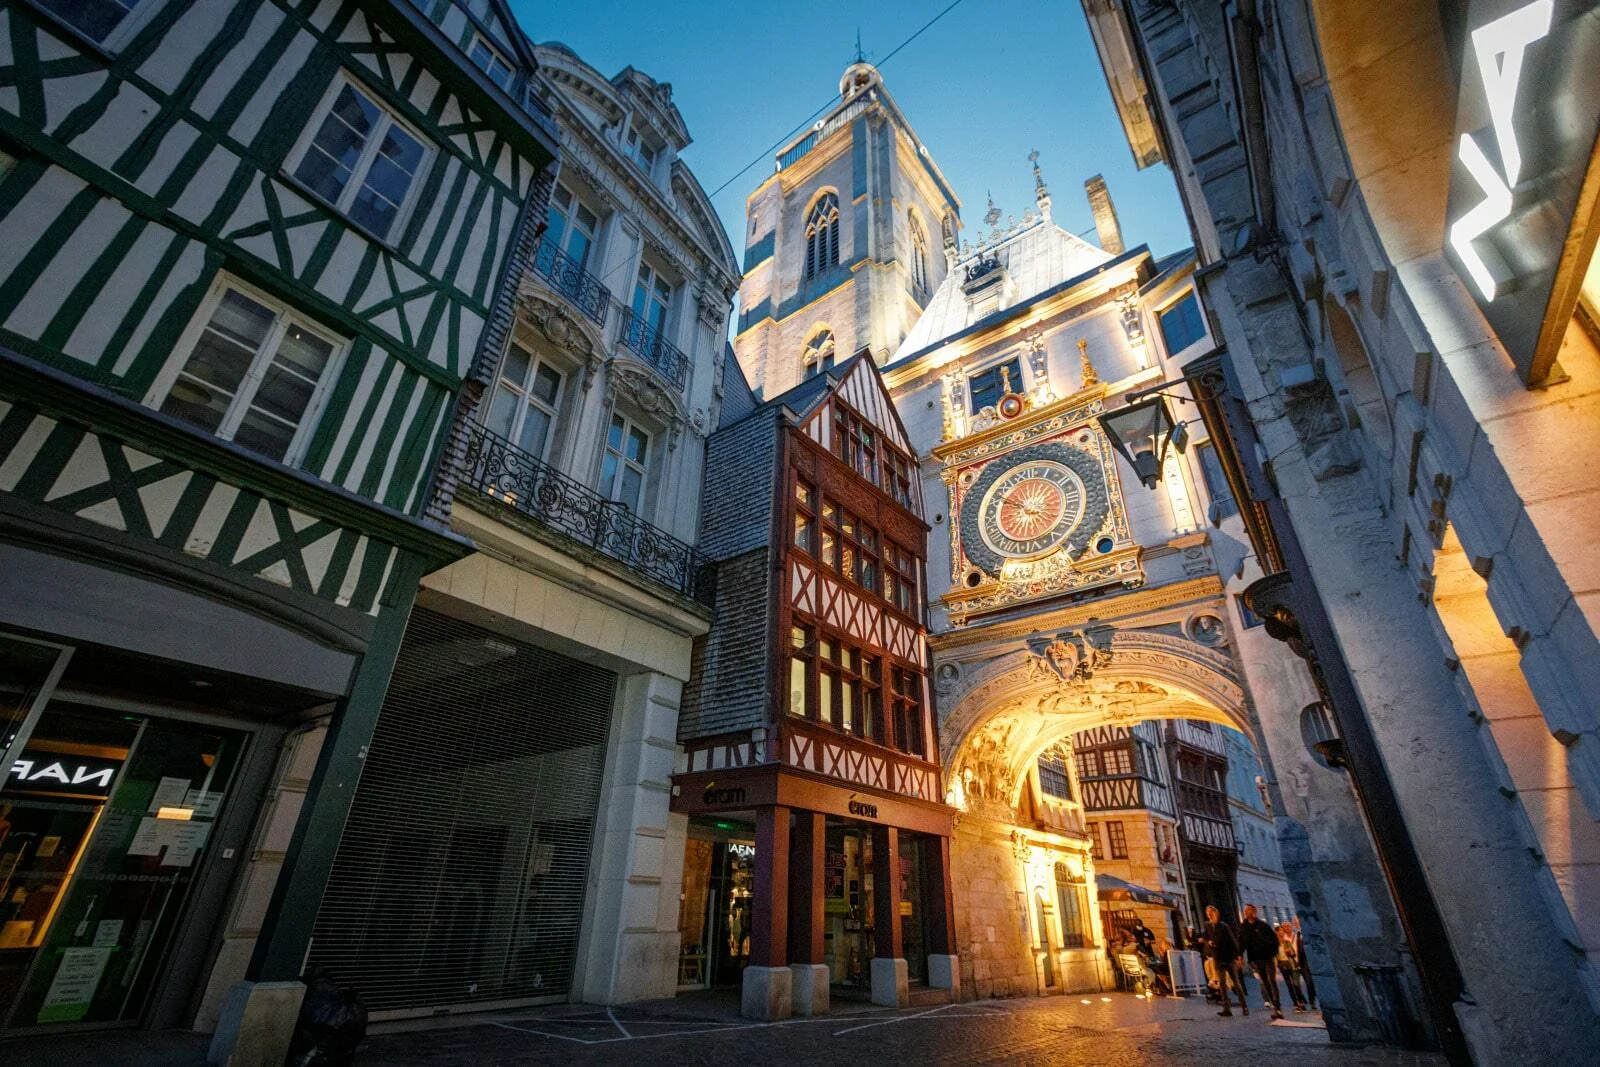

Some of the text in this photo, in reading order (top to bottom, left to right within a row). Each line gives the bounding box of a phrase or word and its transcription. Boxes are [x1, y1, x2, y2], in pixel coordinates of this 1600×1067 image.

[1058, 475, 1070, 487] II
[1066, 490, 1079, 503] III
[1050, 531, 1062, 542] V
[1026, 541, 1042, 552] VI
